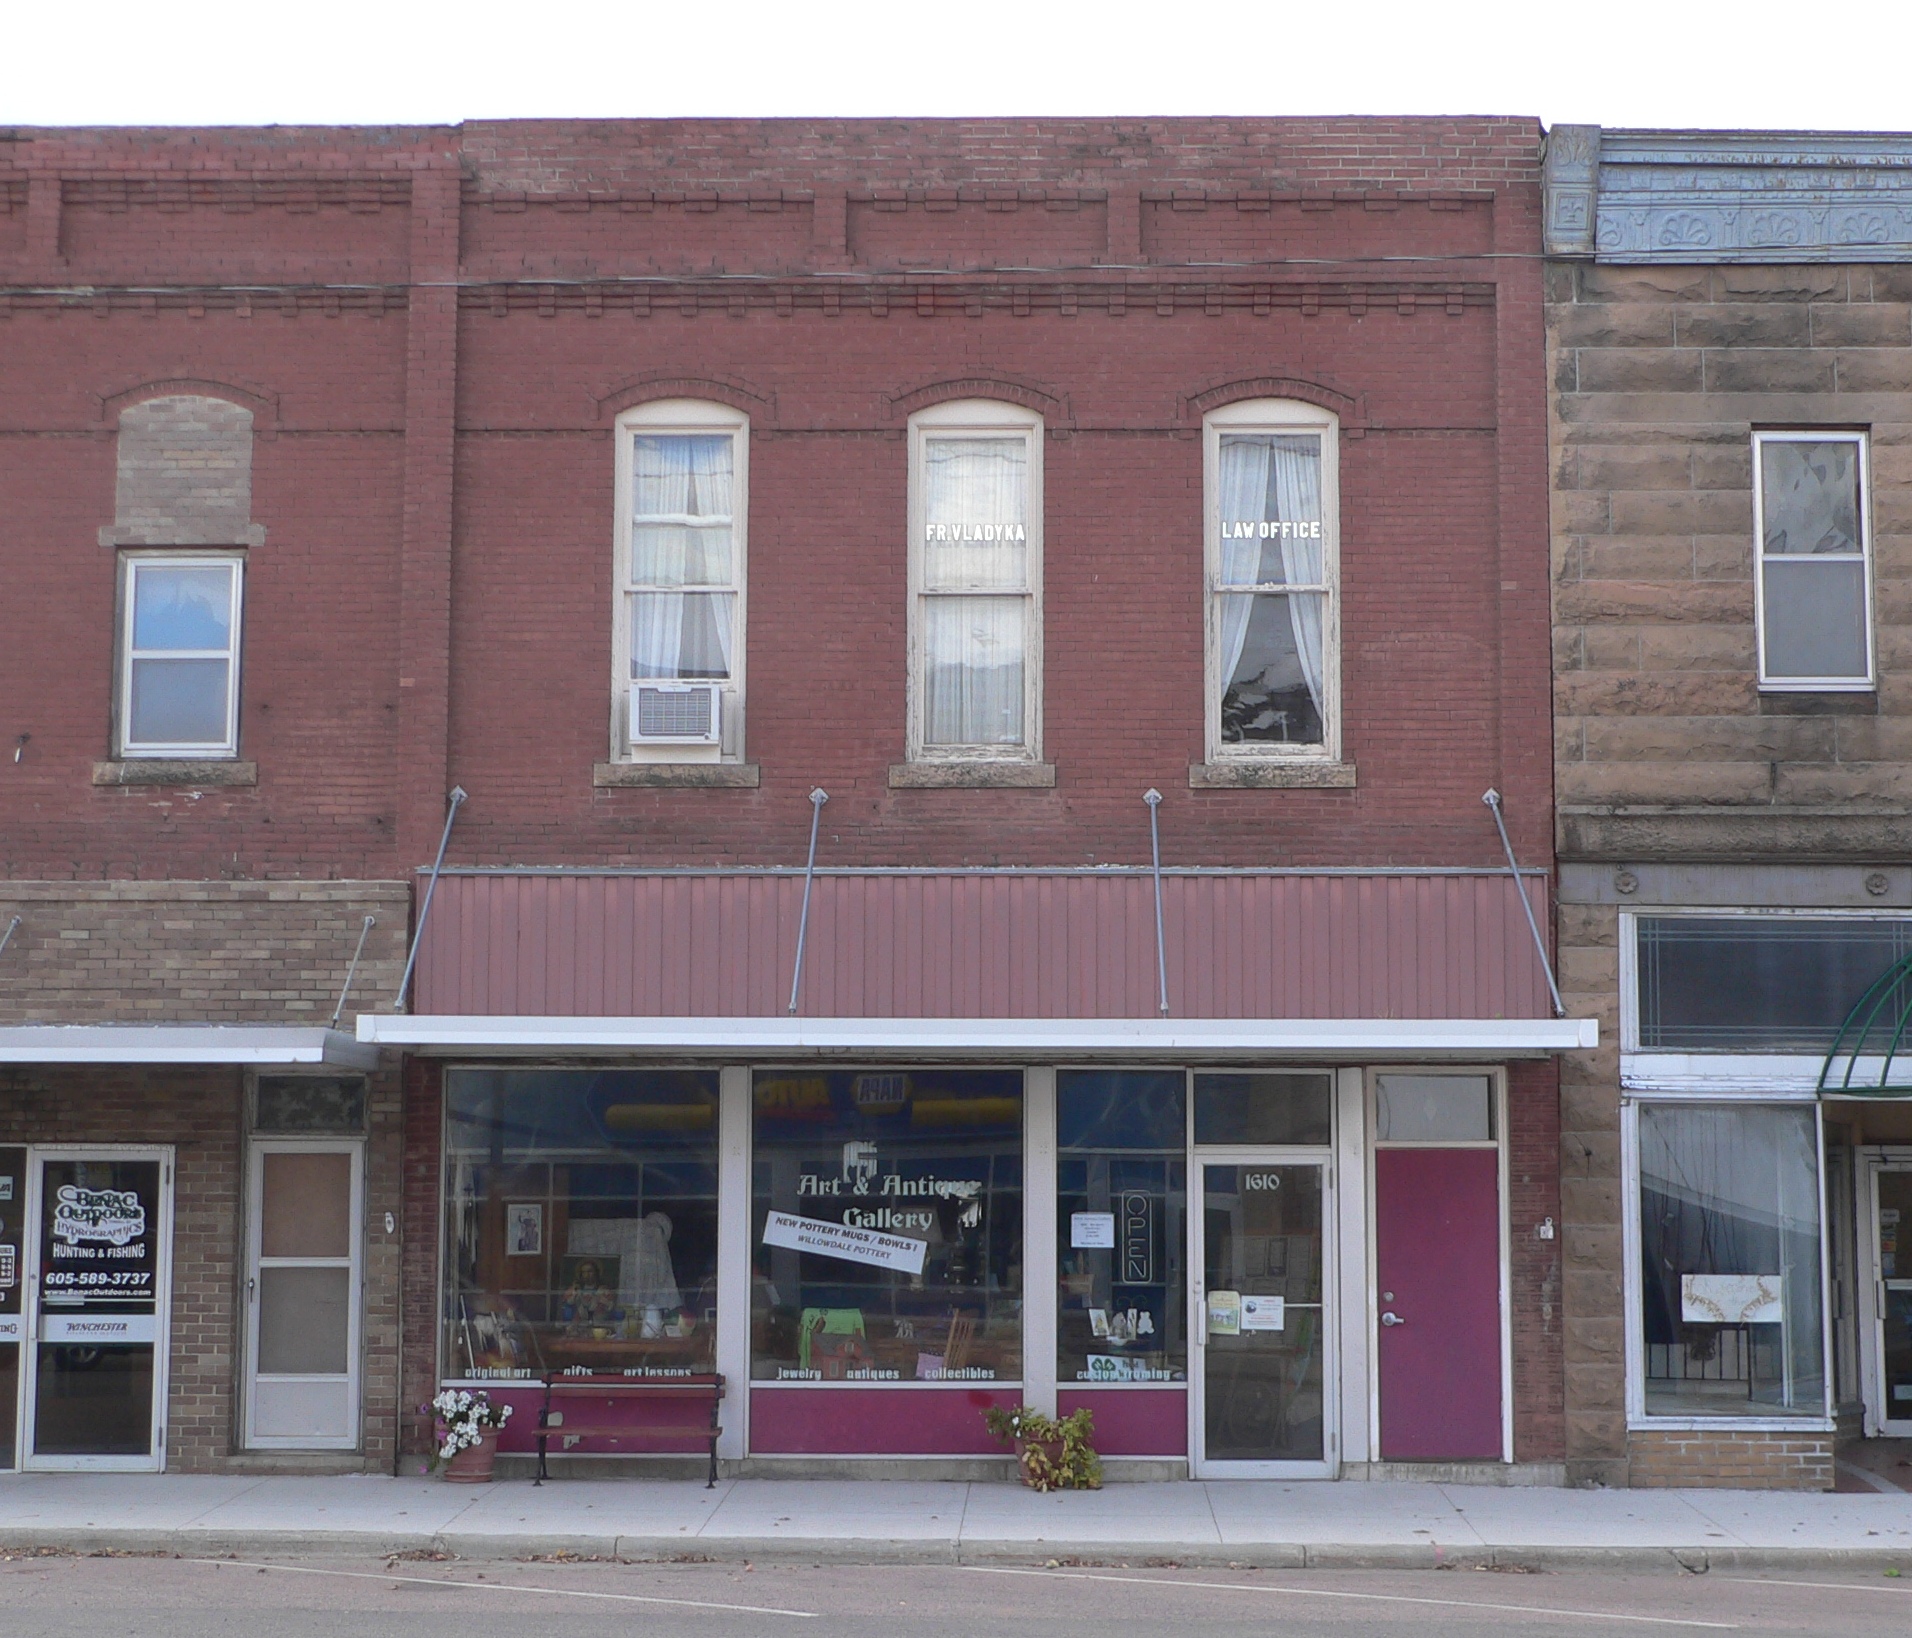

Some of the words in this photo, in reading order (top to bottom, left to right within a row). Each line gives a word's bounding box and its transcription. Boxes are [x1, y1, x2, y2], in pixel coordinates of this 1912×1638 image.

[1222, 521, 1255, 539] LAW
[1259, 521, 1321, 539] OFFICE
[797, 1174, 842, 1196] Art
[853, 1177, 869, 1196] &
[880, 1175, 982, 1200] Antique
[1245, 1173, 1280, 1191] 1610
[843, 1207, 933, 1232] Gallery
[775, 1217, 798, 1229] NEW
[799, 1221, 840, 1237] POTTERY
[841, 1230, 870, 1242] MUGS
[878, 1237, 912, 1251] BOWLS
[1126, 1194, 1147, 1278] OPEN
[53, 1242, 95, 1258] HUNTING
[98, 1248, 105, 1258] &
[107, 1243, 145, 1258] FISHING
[797, 1235, 851, 1253] WILLOWDALE
[852, 1245, 892, 1260] POTTERY
[46, 1272, 151, 1285] 605-589-3737
[66, 1323, 128, 1332] WINCHESTER
[465, 1367, 510, 1379] original
[513, 1368, 531, 1378] art
[564, 1365, 593, 1376] gifts
[623, 1367, 643, 1376] art
[645, 1367, 692, 1376] lessons
[777, 1367, 821, 1380] jewelry
[847, 1367, 899, 1380] antiques
[925, 1367, 995, 1379] collectibles
